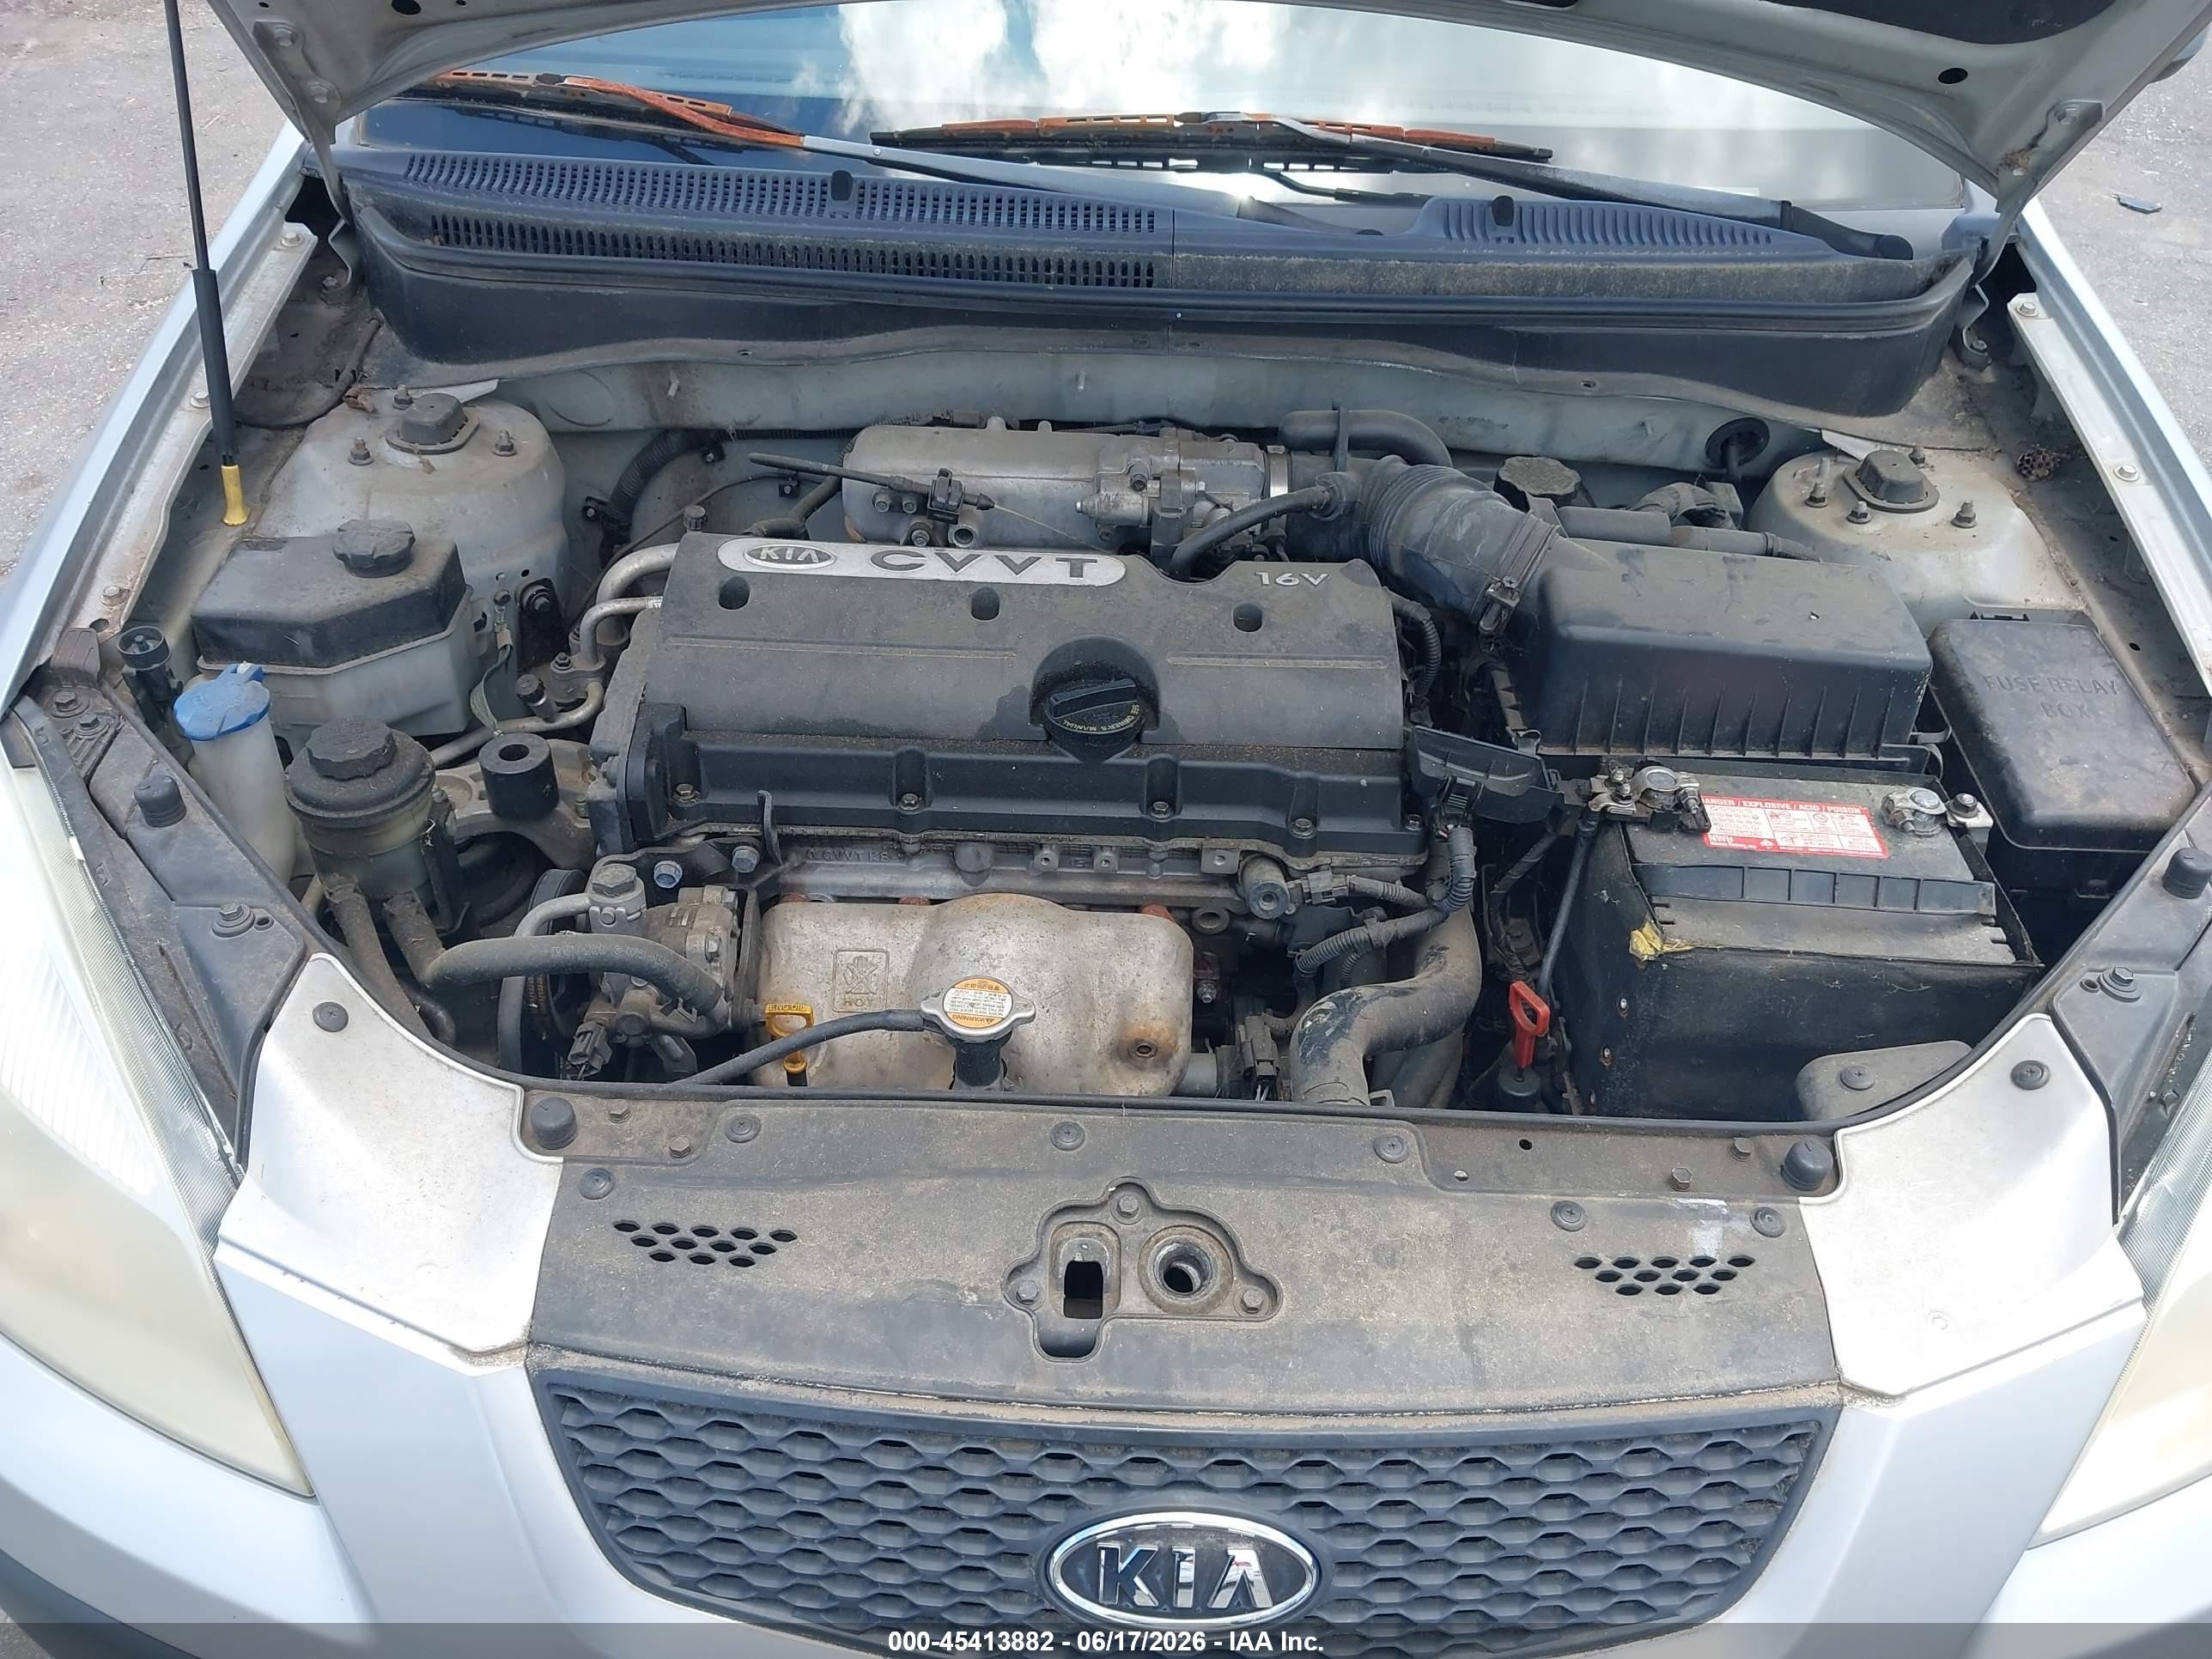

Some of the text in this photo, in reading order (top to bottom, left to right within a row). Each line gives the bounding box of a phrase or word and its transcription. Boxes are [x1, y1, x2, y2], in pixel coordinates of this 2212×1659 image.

[759, 546, 819, 564] KIA
[870, 548, 1098, 579] CVVT
[1255, 571, 1329, 586] 16V
[1982, 674, 2120, 695] FUSE RELAY
[1062, 704, 1140, 732] SEE OWNER'S MANUAL
[2040, 702, 2093, 719] BOX
[1742, 800, 1792, 811] EXPLOSIVE
[1798, 804, 1820, 812] ACID
[1826, 805, 1862, 815] POISON
[769, 1003, 805, 1012] ENG OIL
[843, 997, 879, 1007] HOT
[1097, 1542, 1273, 1608] KIA
